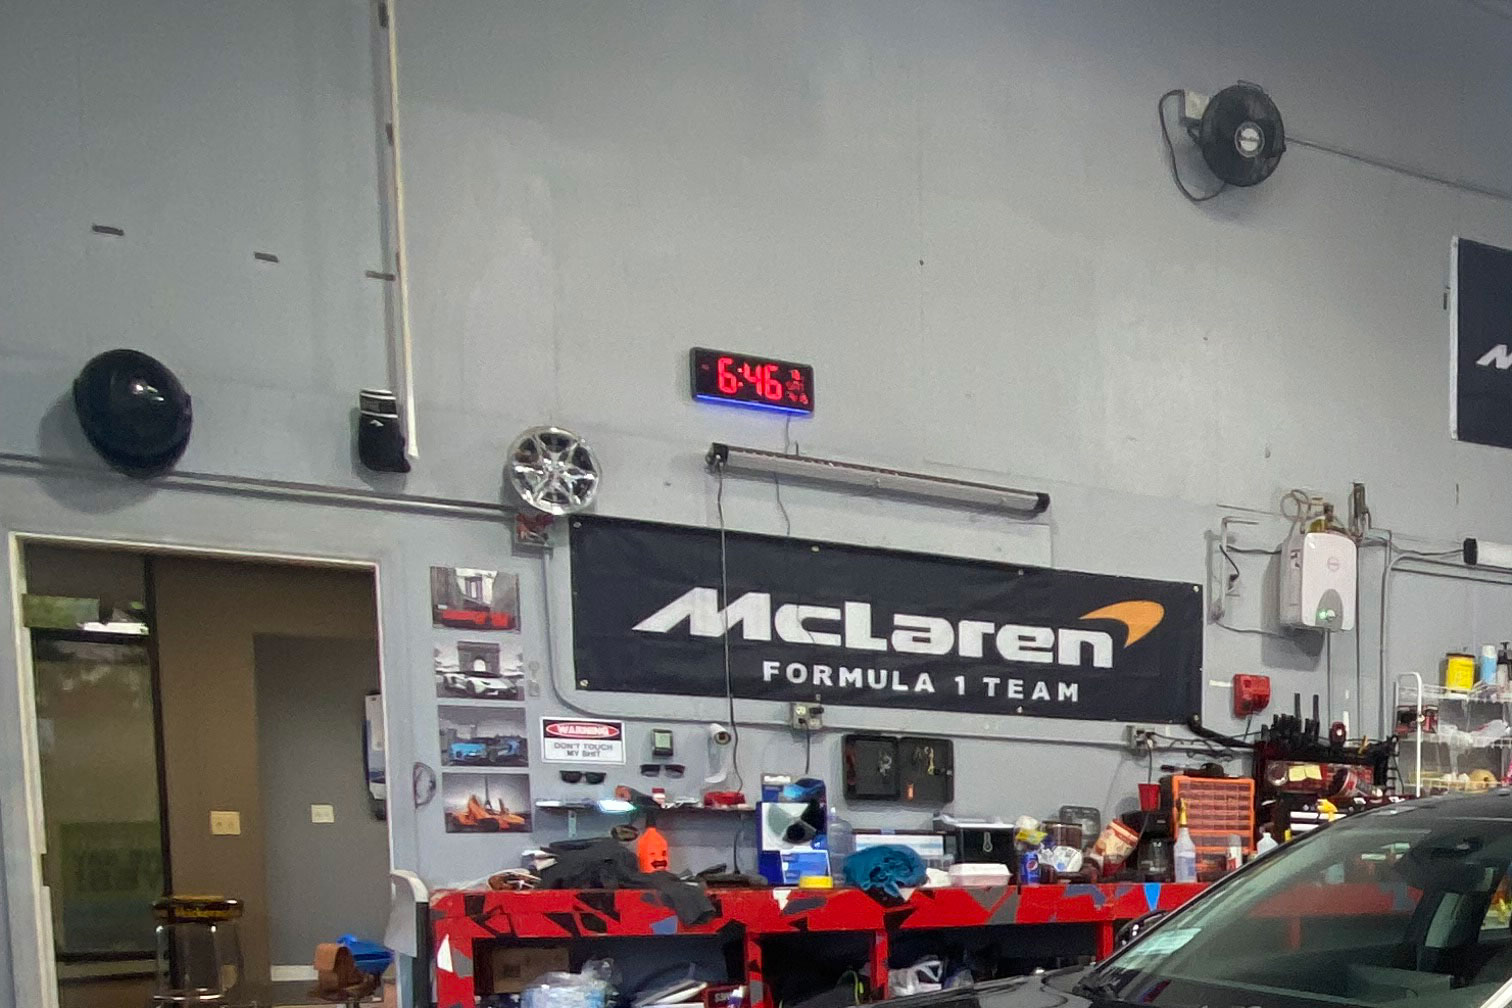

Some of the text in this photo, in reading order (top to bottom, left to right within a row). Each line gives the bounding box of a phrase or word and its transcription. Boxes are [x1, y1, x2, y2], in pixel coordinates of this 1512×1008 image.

[717, 357, 783, 401] 6:46
[631, 587, 1113, 669] McLaren
[762, 660, 1079, 703] FORMULA 1 TEAM
